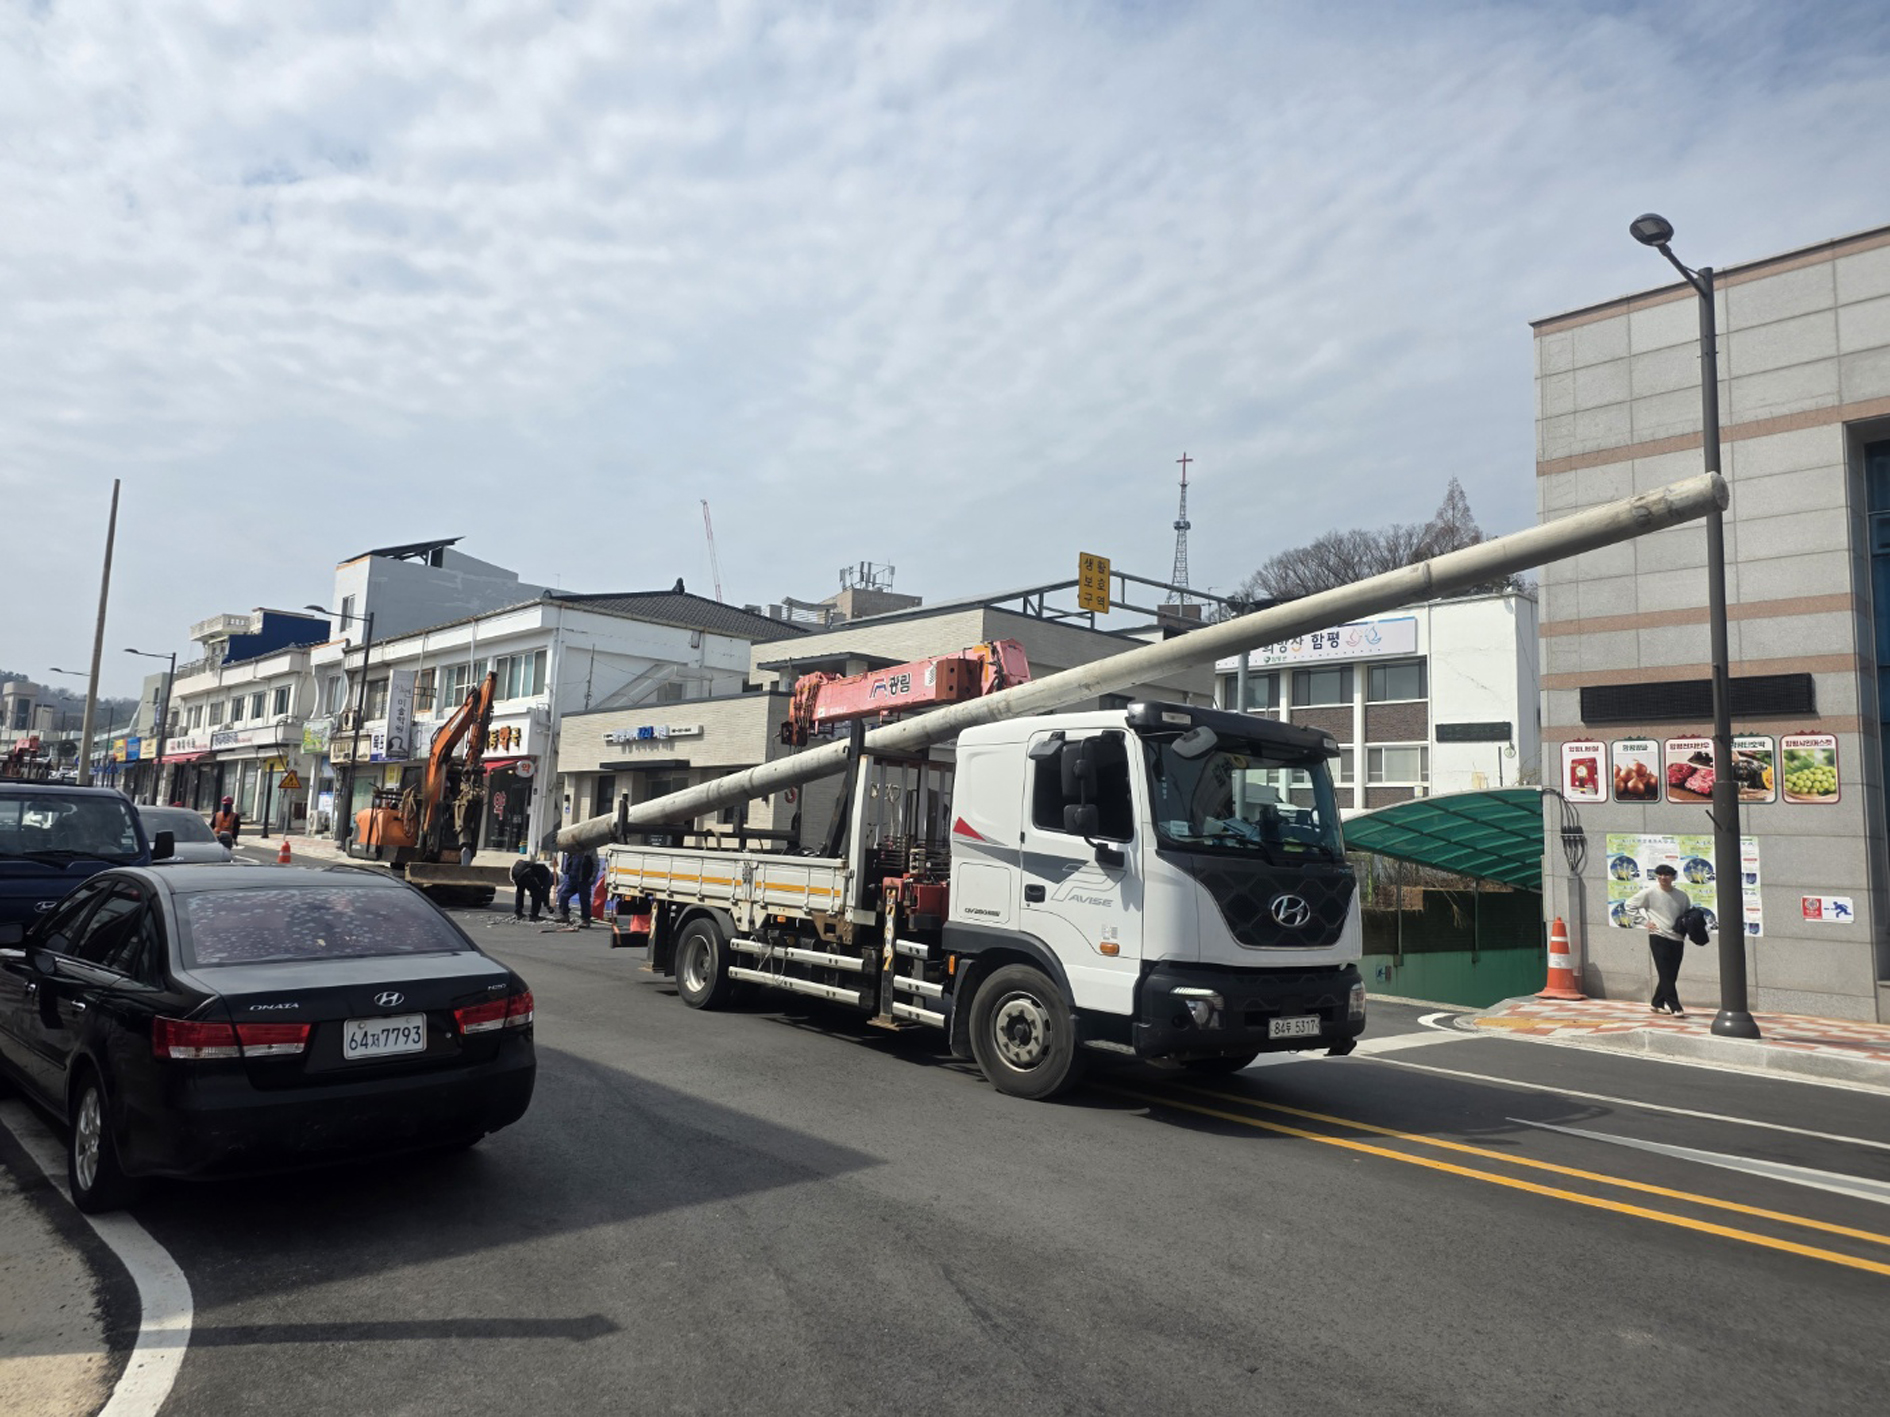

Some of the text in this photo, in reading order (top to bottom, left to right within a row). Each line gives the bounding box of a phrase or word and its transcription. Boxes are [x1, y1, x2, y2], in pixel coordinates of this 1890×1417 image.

[1311, 631, 1340, 651] 함평
[888, 672, 912, 696] 광림
[521, 762, 532, 774] 약
[1295, 1019, 1316, 1034] 5317
[348, 1025, 421, 1051] 64저7793
